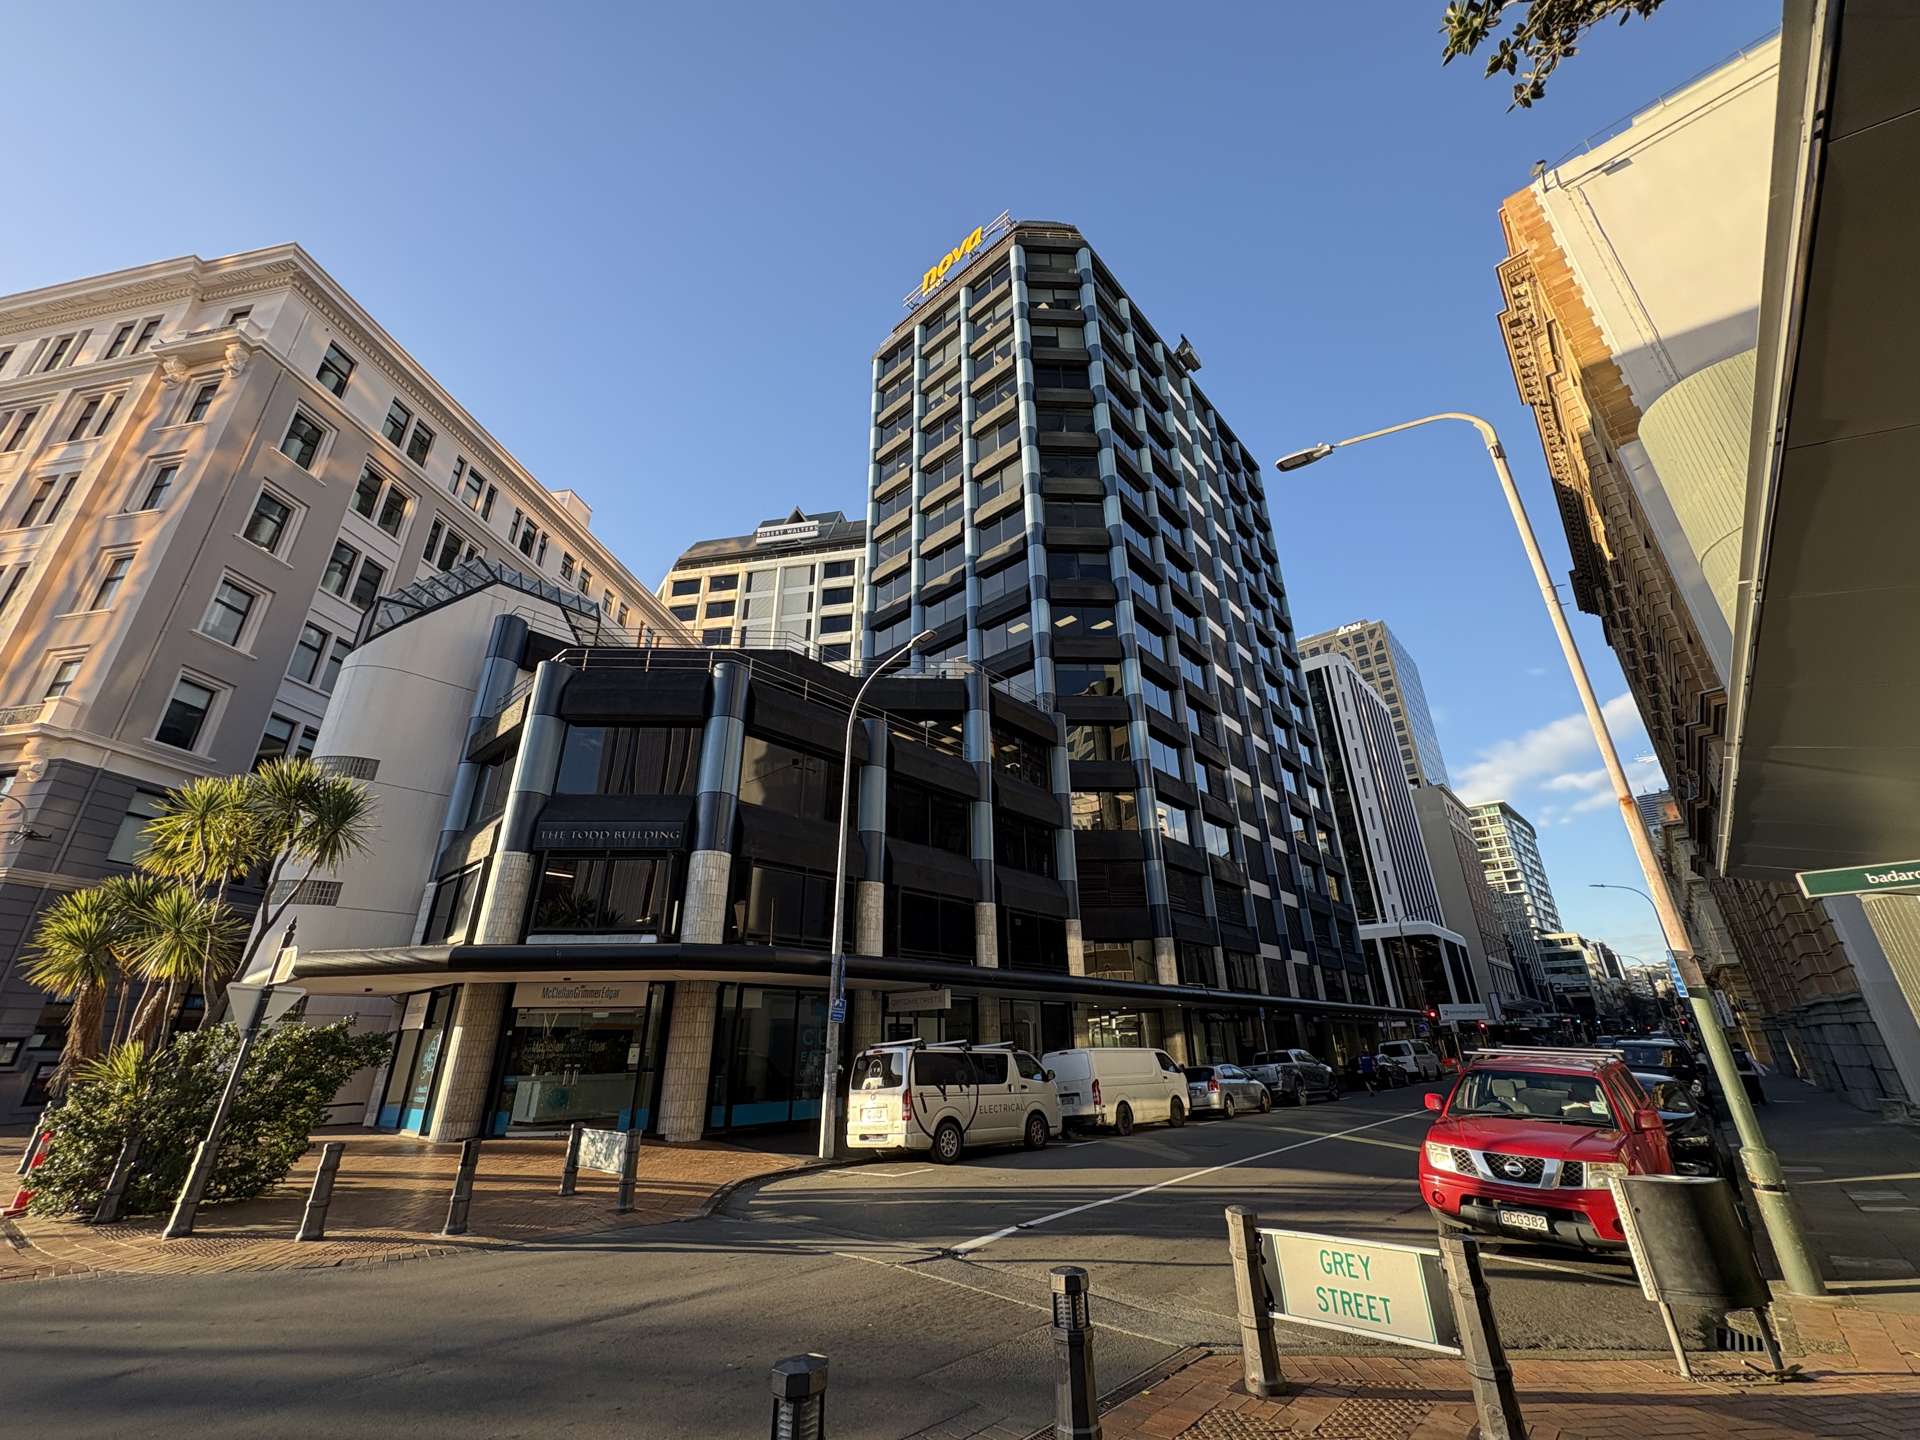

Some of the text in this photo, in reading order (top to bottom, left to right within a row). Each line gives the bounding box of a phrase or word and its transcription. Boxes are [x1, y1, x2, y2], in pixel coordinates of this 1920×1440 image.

[922, 226, 983, 292] nova
[541, 830, 681, 840] THE TODD BUILDING
[979, 1103, 1025, 1115] ELECTRICAL
[1502, 1211, 1547, 1229] GCG382
[1319, 1249, 1370, 1280] GREY
[1316, 1286, 1391, 1324] STREET
